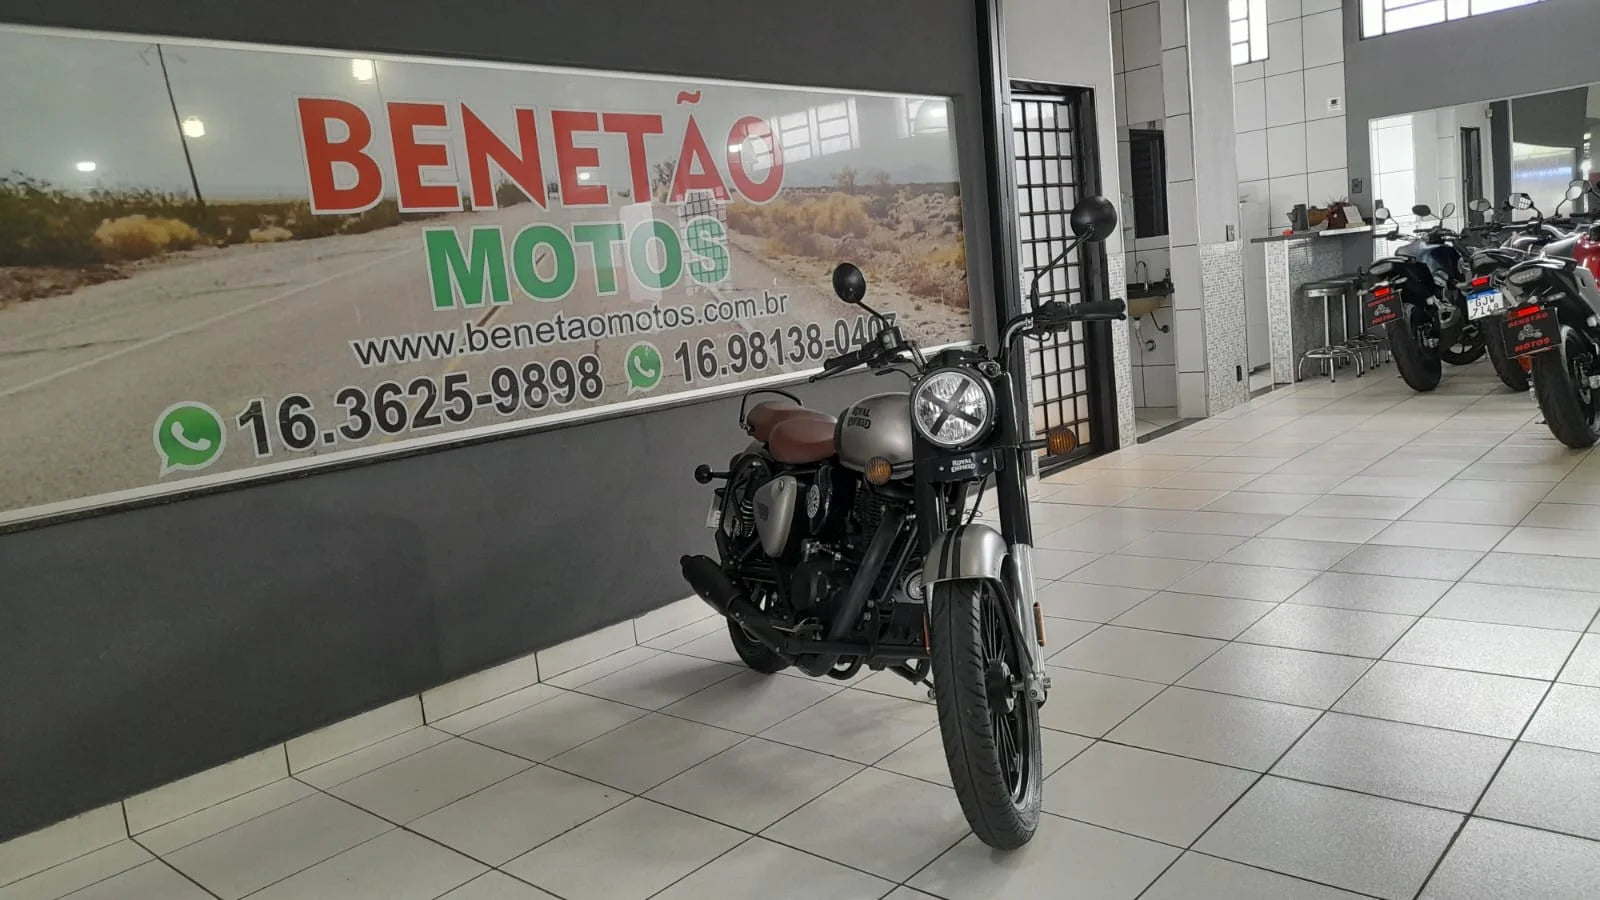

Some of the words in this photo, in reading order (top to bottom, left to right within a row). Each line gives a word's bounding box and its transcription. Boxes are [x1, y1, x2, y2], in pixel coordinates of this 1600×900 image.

[297, 90, 785, 212] BENETÃO
[424, 218, 730, 309] MOTOS
[354, 291, 788, 366] www.benetaomotos.com.br
[238, 355, 601, 457] 16.3625-9898
